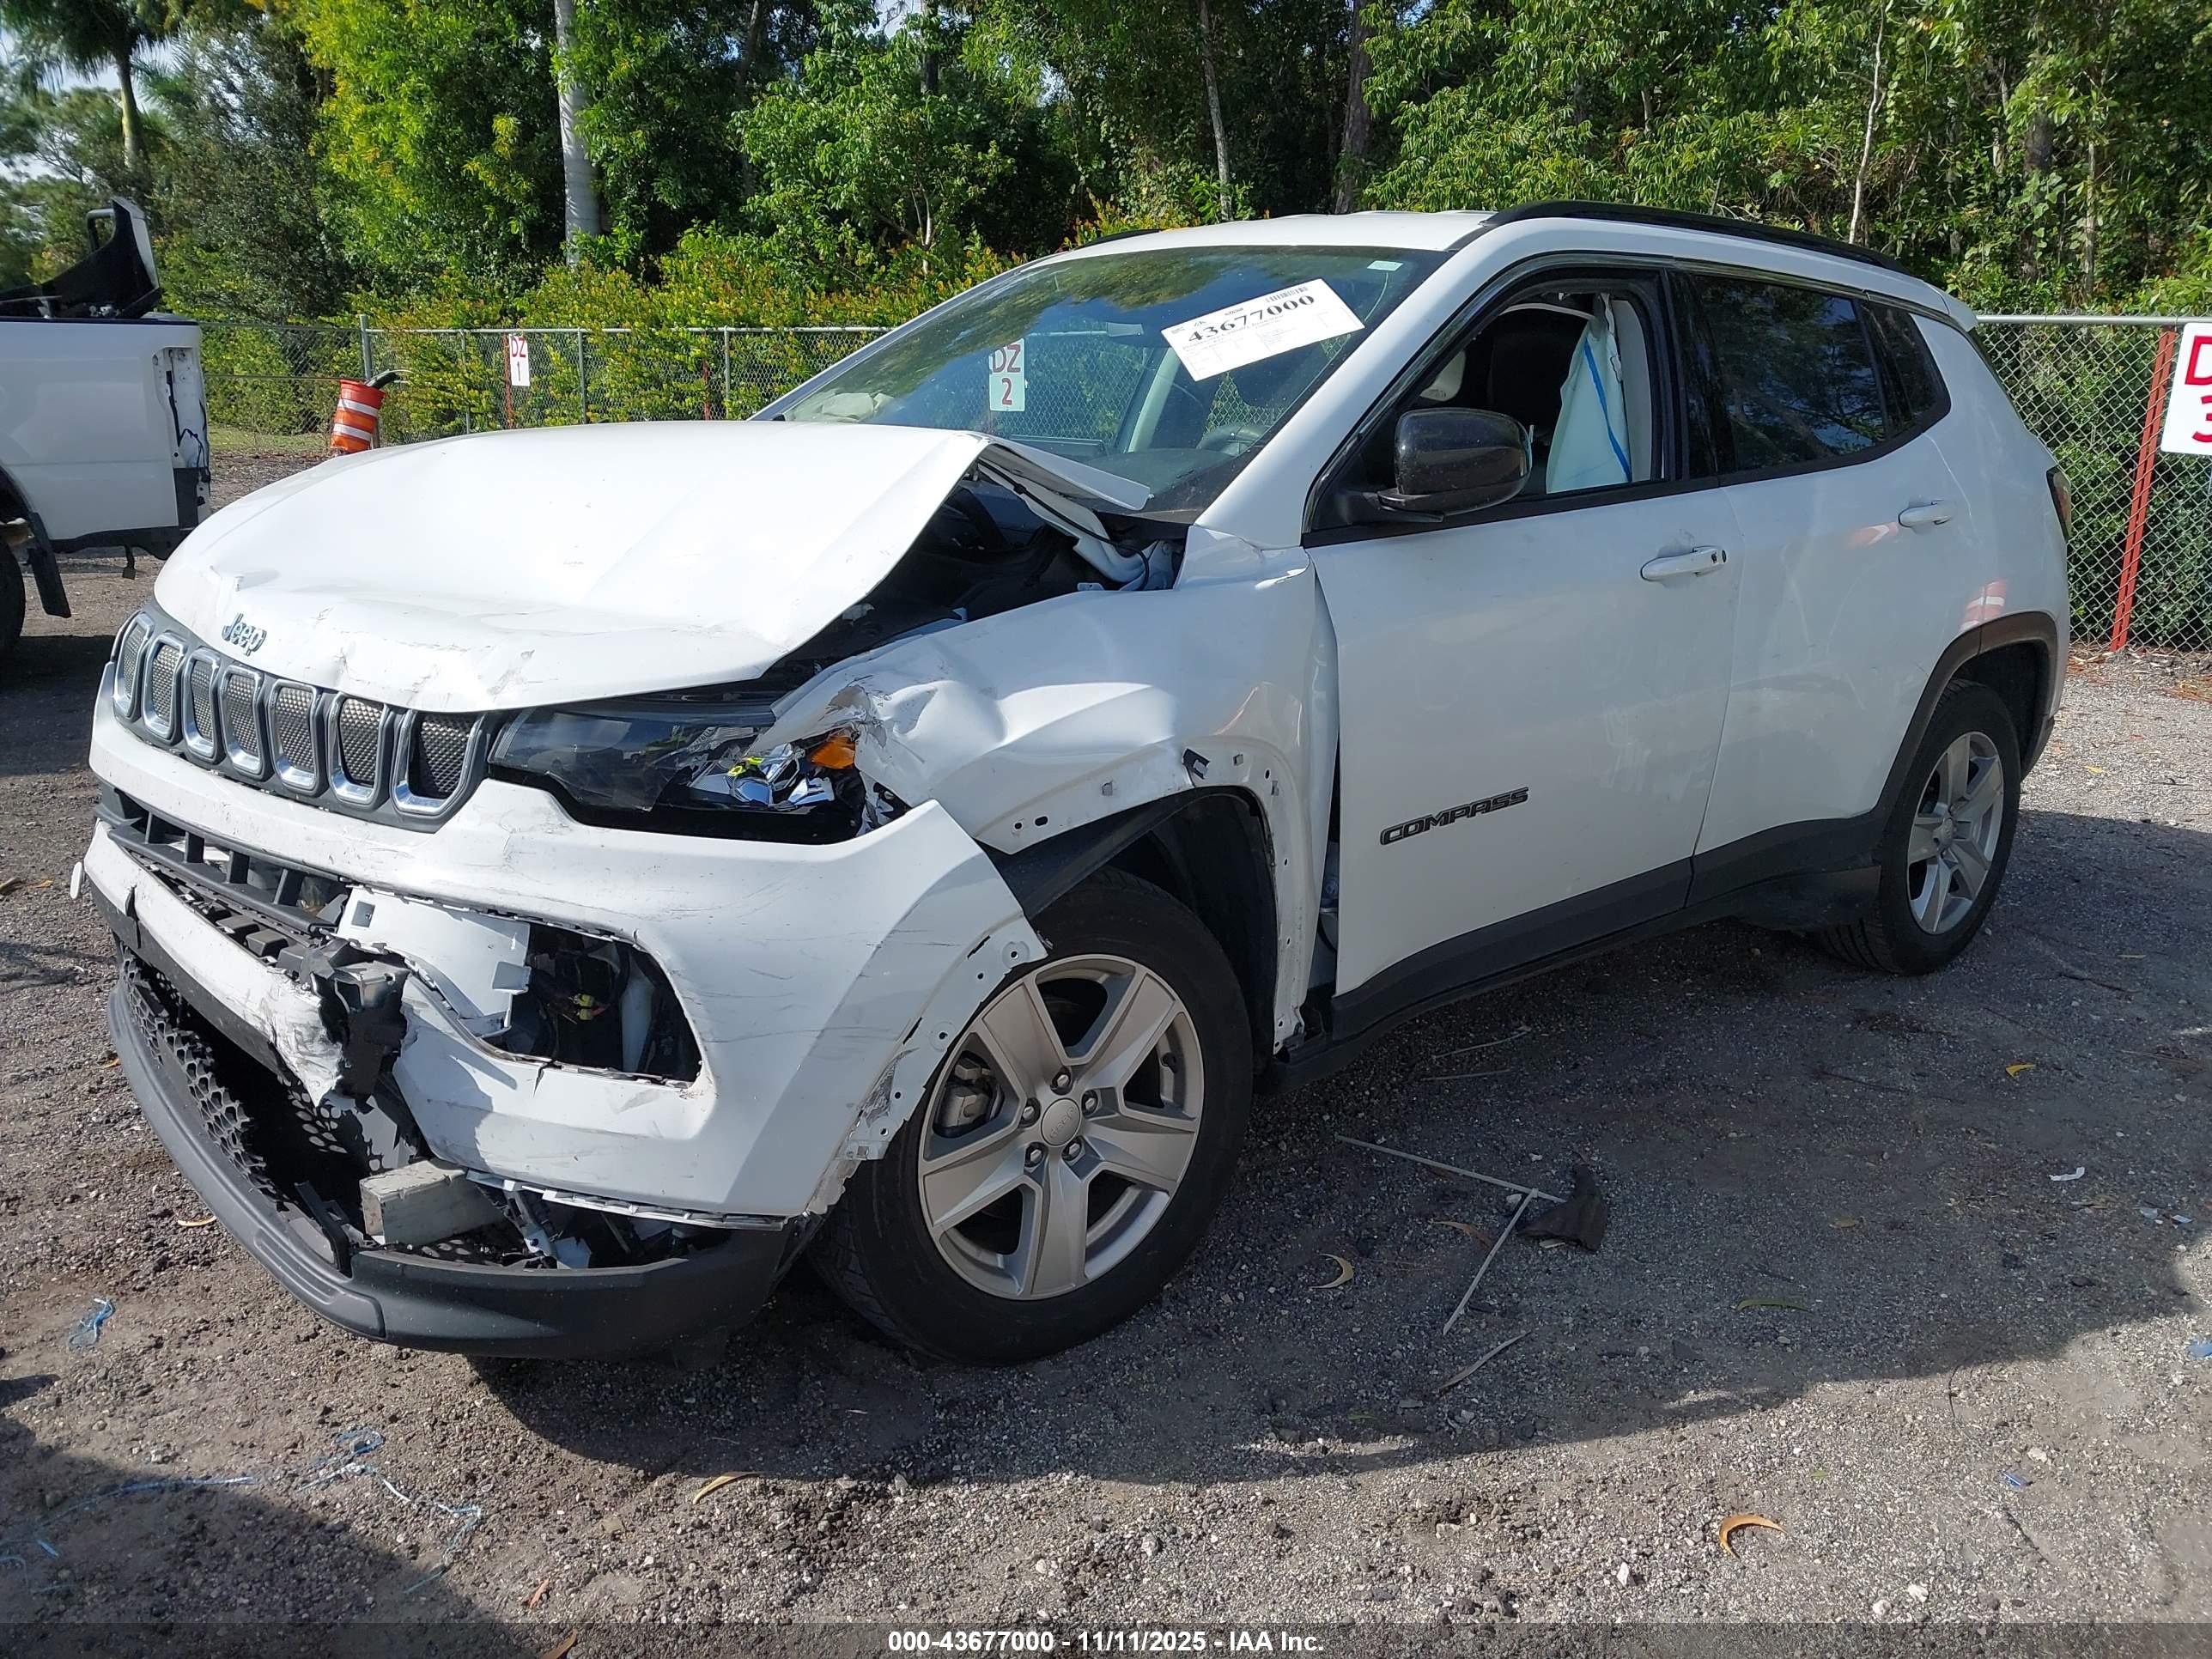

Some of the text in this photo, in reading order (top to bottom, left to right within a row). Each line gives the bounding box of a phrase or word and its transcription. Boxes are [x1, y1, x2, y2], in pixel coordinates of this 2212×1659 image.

[1188, 295, 1315, 342] 43677000
[511, 336, 526, 358] DZ
[992, 343, 1022, 374] DZ
[516, 361, 521, 382] 1
[1001, 377, 1012, 405] 2
[222, 612, 267, 657] Jeep
[1380, 787, 1529, 845] COMPASS
